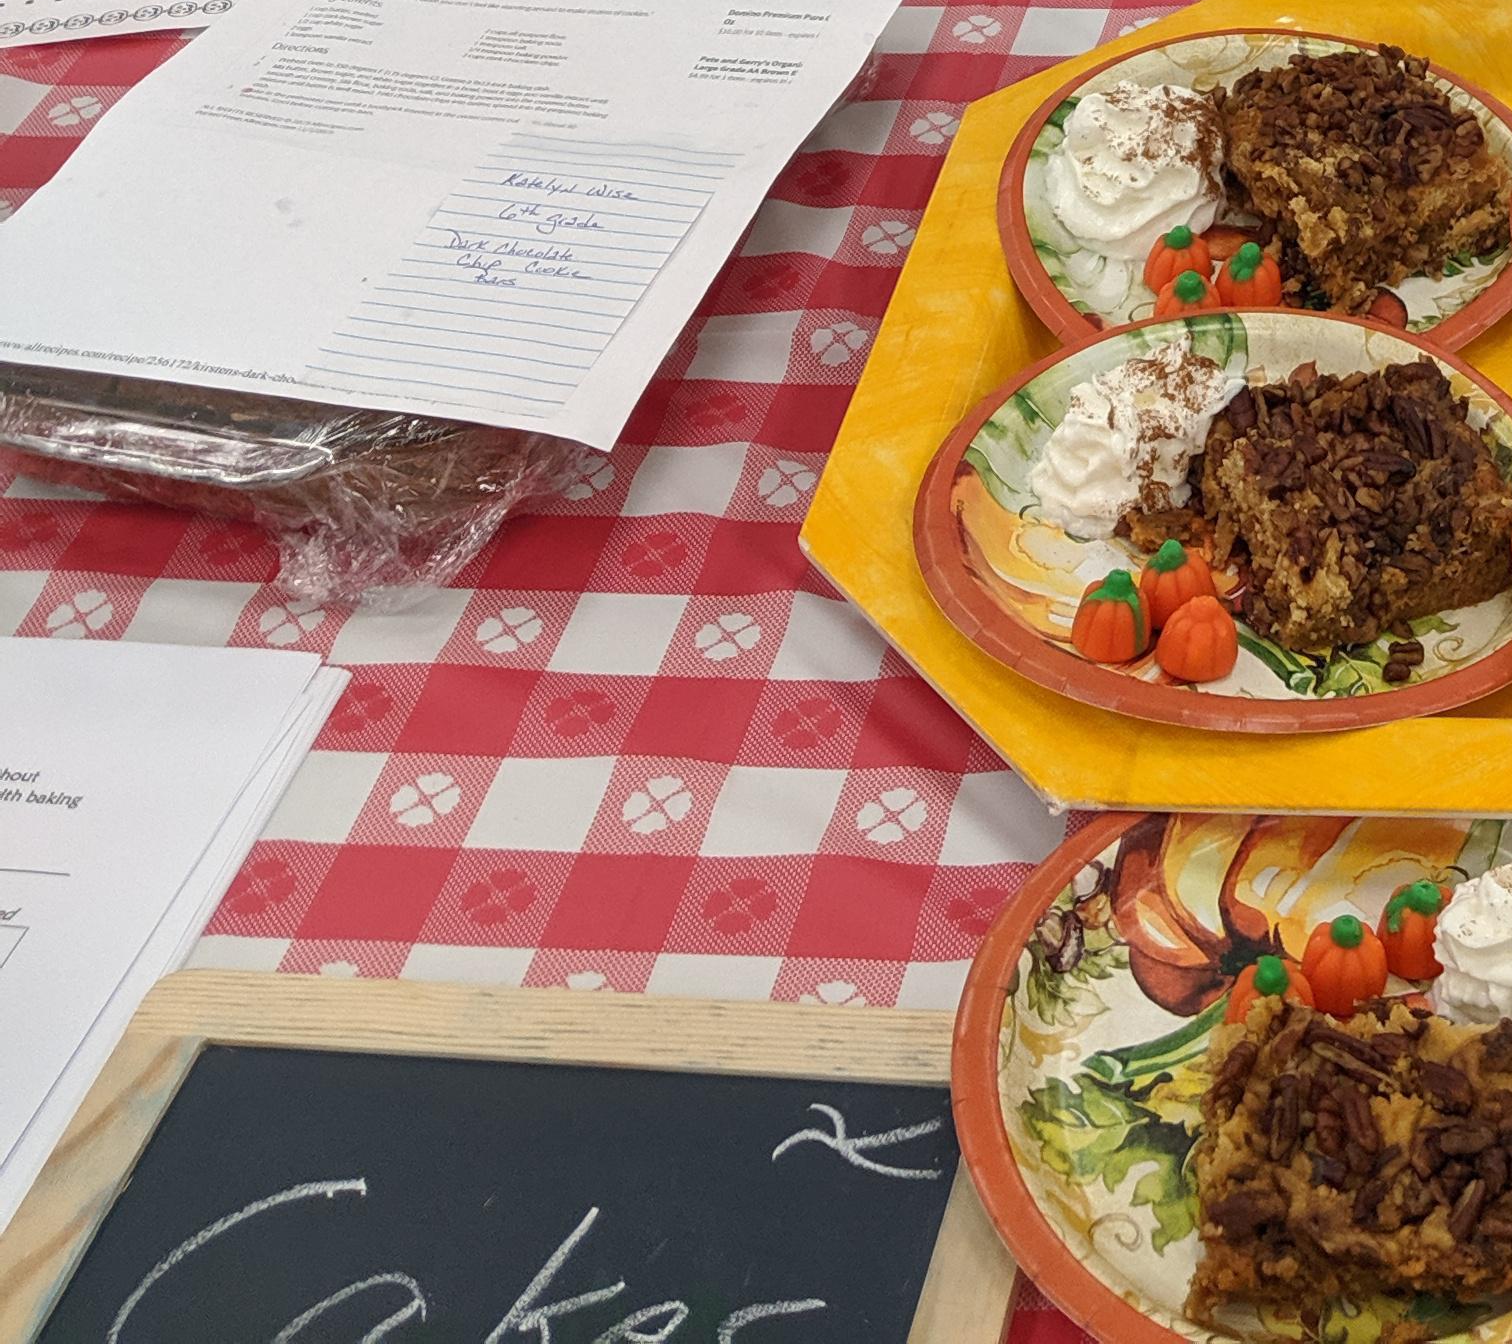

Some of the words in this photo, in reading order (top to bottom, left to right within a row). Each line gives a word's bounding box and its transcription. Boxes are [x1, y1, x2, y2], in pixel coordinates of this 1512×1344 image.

[271, 41, 330, 55] Directions
[498, 203, 541, 221] 6th
[443, 228, 490, 251] Dark
[493, 240, 575, 261] Chocolate
[456, 252, 503, 275] Chip
[524, 260, 592, 280] Cookie
[0, 767, 40, 783] hout
[0, 788, 23, 802] ith
[25, 790, 84, 809] baking
